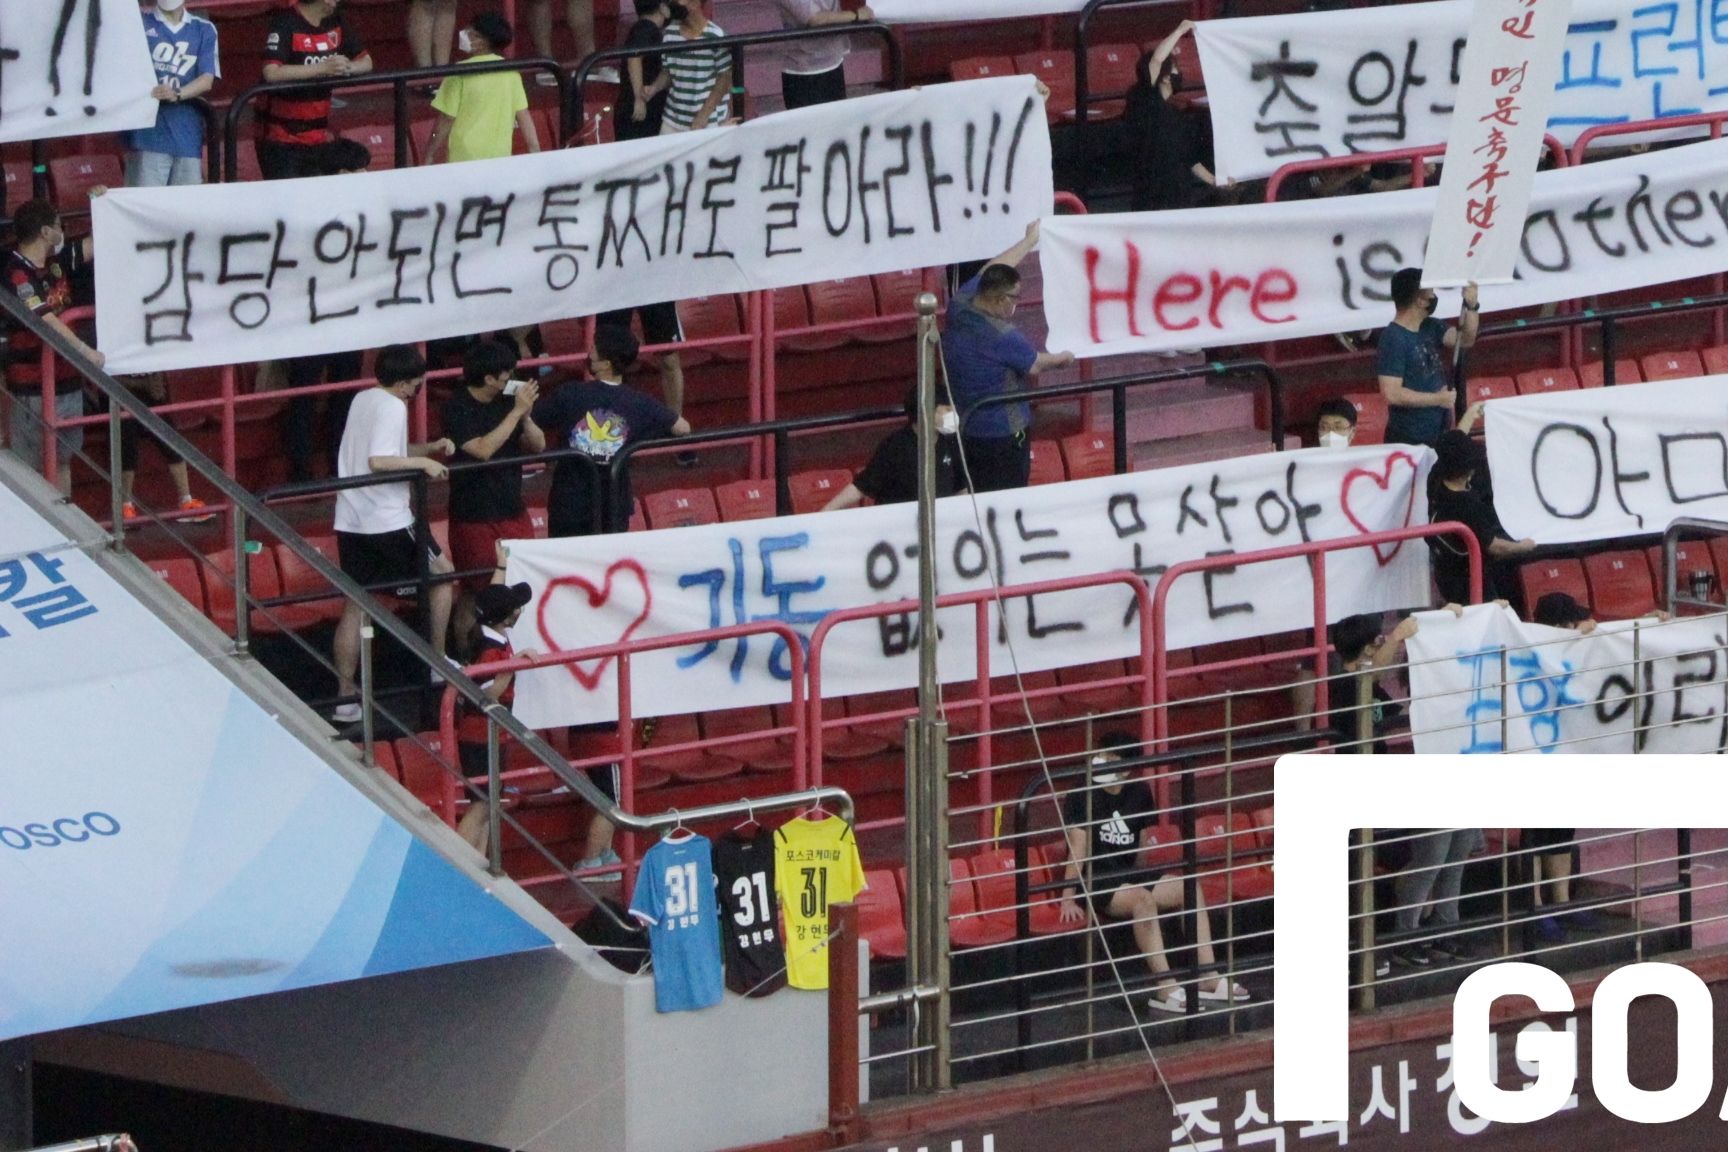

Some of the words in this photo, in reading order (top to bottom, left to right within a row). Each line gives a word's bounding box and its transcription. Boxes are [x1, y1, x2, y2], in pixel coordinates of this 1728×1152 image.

[533, 155, 743, 292] 통째로
[1084, 242, 1298, 343] Here
[1333, 234, 1403, 310] is
[785, 849, 841, 862] 포스코케미칼
[664, 861, 700, 917] 31
[731, 871, 771, 927] 31
[801, 867, 827, 919] 31
[1170, 1058, 1417, 1152] 주식사
